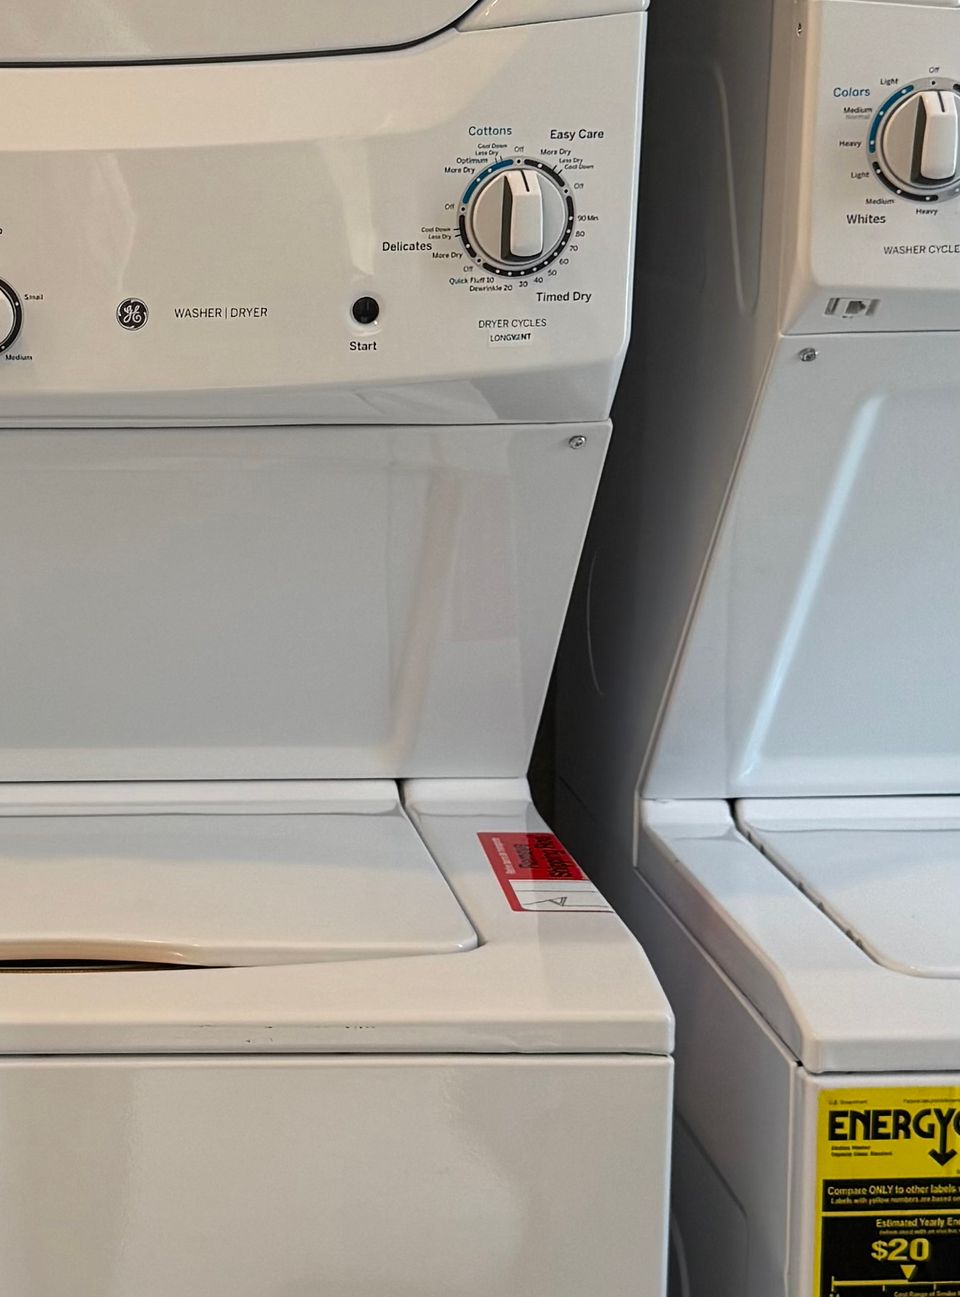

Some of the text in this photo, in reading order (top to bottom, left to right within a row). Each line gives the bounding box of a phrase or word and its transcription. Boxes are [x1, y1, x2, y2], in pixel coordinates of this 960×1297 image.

[833, 87, 871, 98] Colors
[843, 106, 873, 114] Medium
[468, 126, 513, 136] Cottons
[550, 129, 605, 142] Easy Care
[839, 140, 862, 149] Heavy
[461, 167, 476, 175] Dry
[851, 171, 870, 180] Light
[865, 198, 895, 206] Medium
[915, 207, 938, 216] Heavy
[846, 214, 886, 225] Whites
[382, 241, 432, 252] Delicates
[883, 245, 927, 255] WASHER
[449, 252, 463, 260] Dry
[547, 269, 557, 277] 50
[536, 292, 592, 304] Timed Dry
[174, 307, 268, 318] WASHER DRYER
[478, 318, 547, 329] DRYER CYCLES
[349, 341, 377, 352] Start
[5, 354, 33, 362] Medium
[827, 1186, 868, 1196] Compare
[868, 1184, 894, 1195] ONLY
[895, 1185, 905, 1194] to
[906, 1184, 929, 1194] other
[871, 1237, 930, 1262] $20
